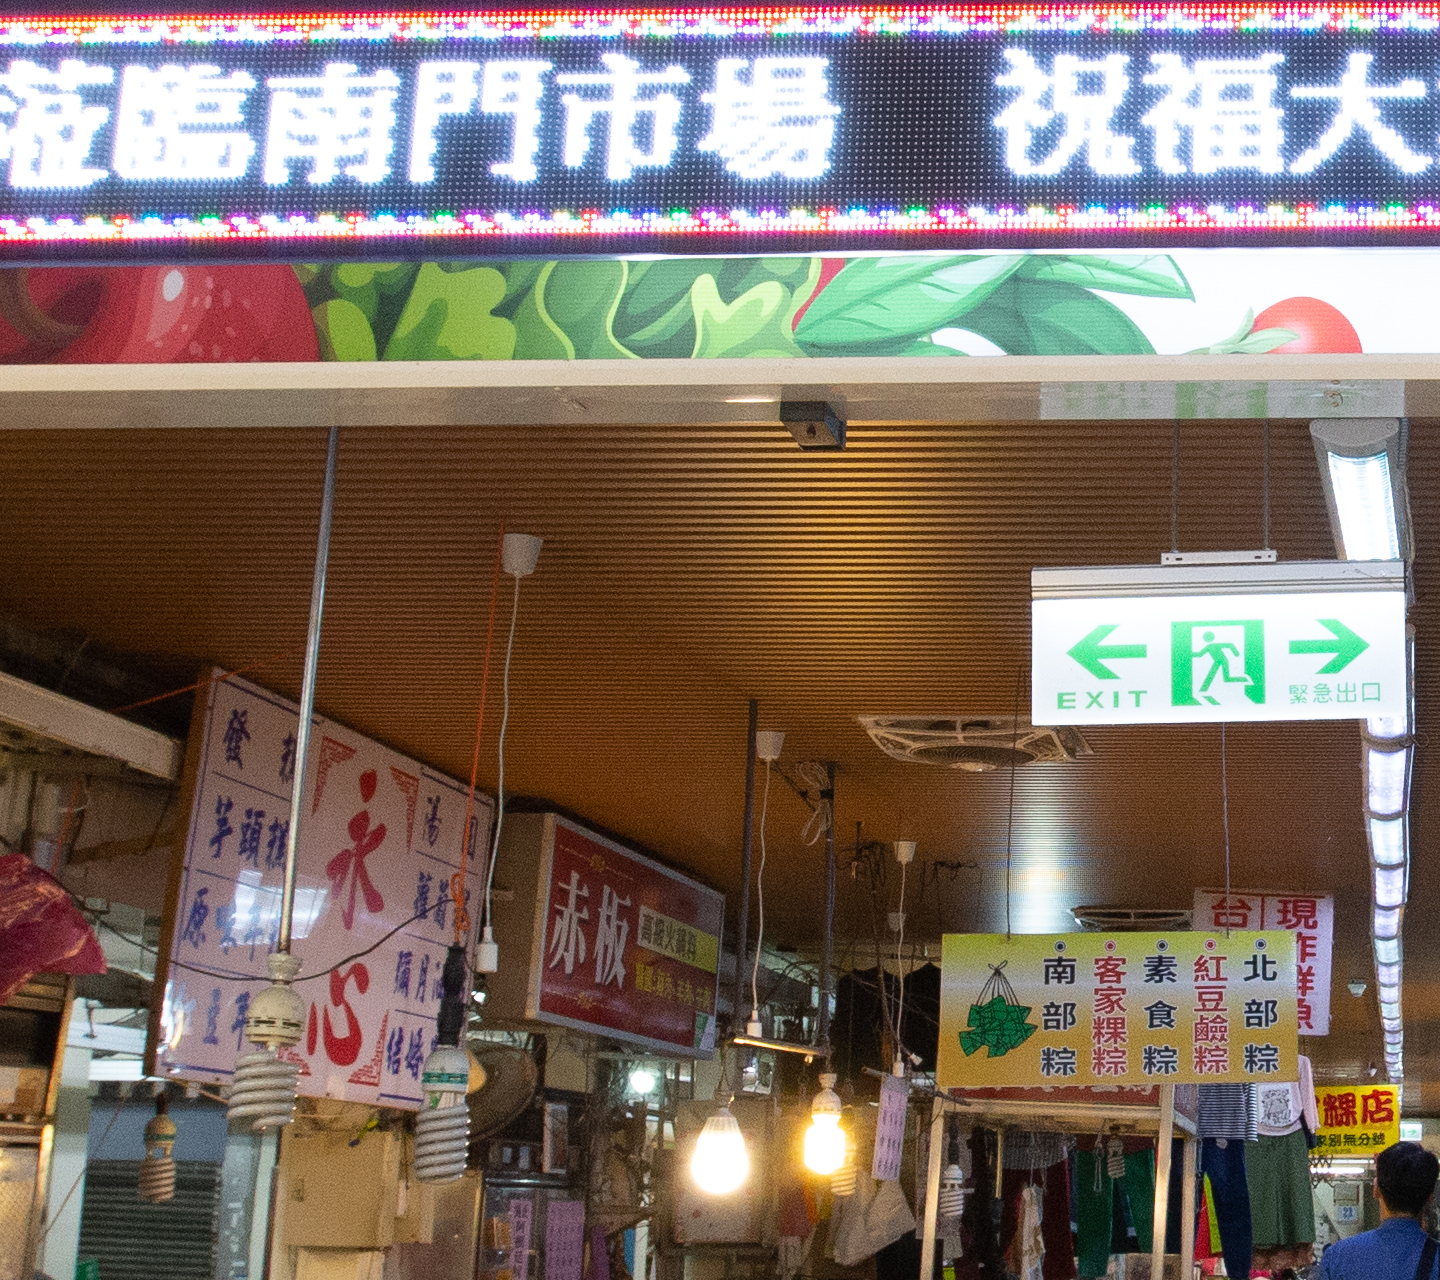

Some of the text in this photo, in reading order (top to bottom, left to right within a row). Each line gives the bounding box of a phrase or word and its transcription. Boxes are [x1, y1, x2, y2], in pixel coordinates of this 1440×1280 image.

[1056, 690, 1148, 711] EXIT
[1288, 681, 1382, 706] 緊急出口
[306, 767, 385, 1067] 永心
[548, 869, 632, 988] 赤板
[1040, 955, 1077, 1077] 南部粽
[1091, 955, 1130, 1077] 客家粿粽
[1141, 954, 1180, 1077] 素食粽
[1192, 953, 1230, 1076] 紅豆鹼粽
[1242, 953, 1280, 1075] 北部粽
[1316, 1089, 1395, 1128] 粿店
